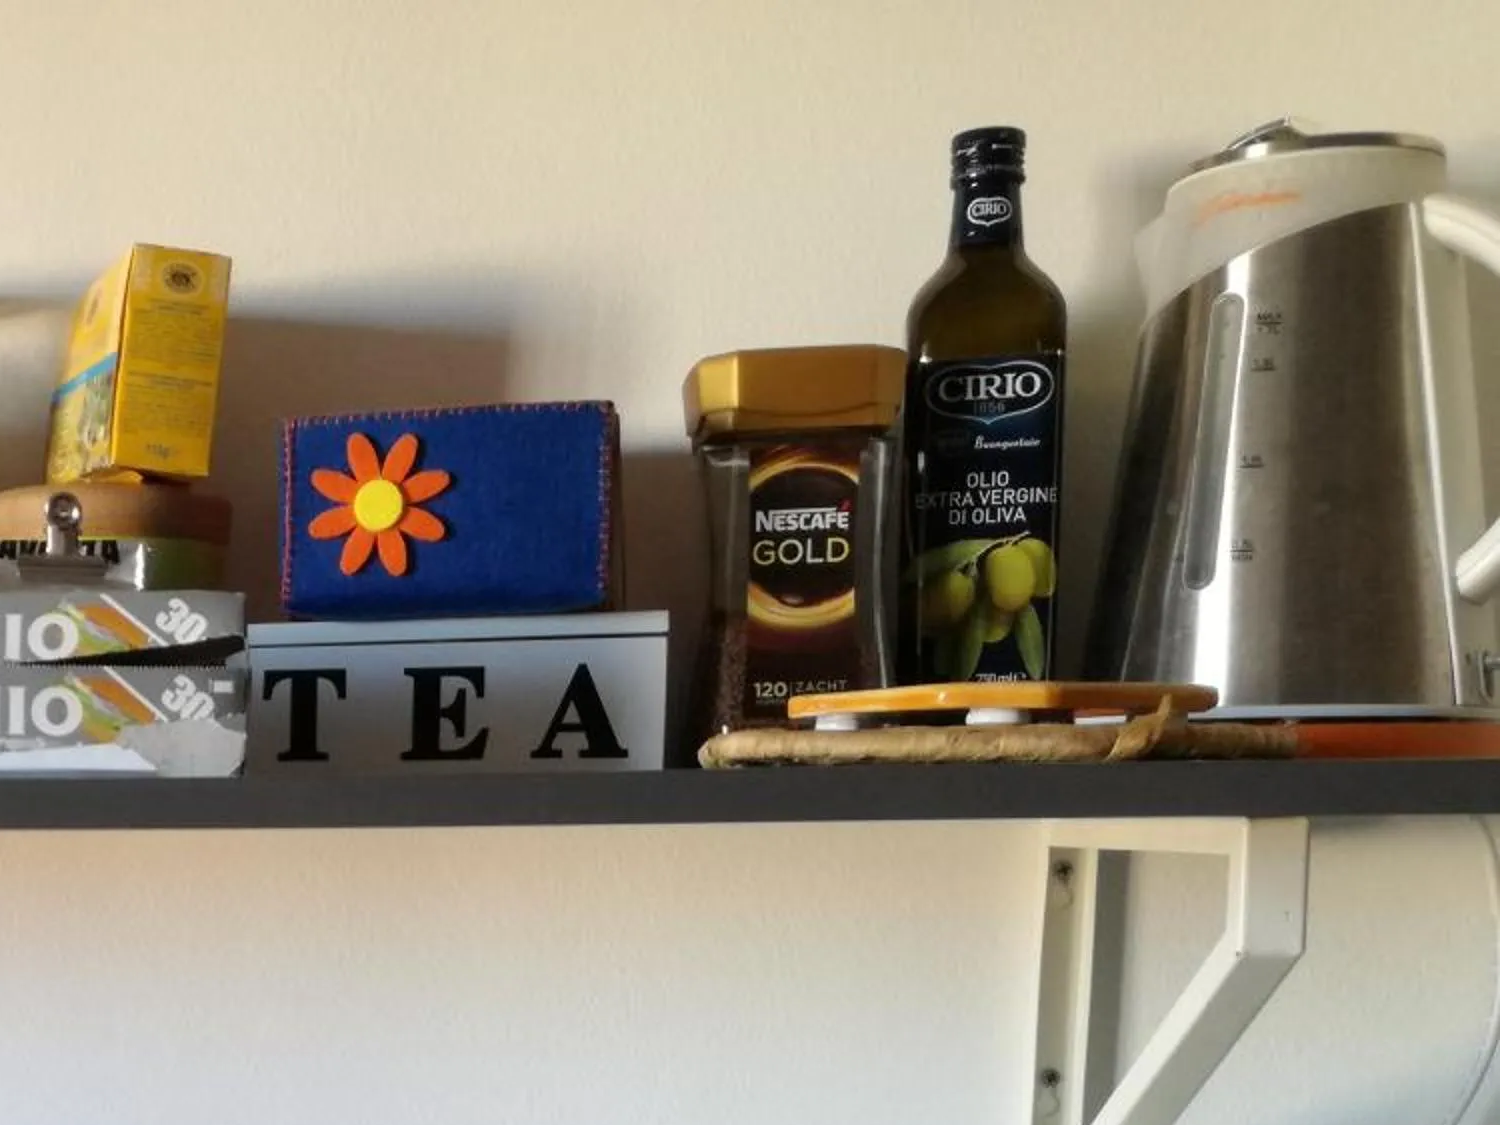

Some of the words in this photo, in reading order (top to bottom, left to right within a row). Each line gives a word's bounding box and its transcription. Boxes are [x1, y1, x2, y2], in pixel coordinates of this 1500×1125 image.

[971, 203, 1007, 217] CIRIO
[939, 371, 1042, 403] CIRIO
[966, 471, 1010, 489] OLIO
[916, 490, 974, 509] EXTRA
[978, 486, 1059, 506] VERGINE
[949, 508, 967, 526] DI
[971, 505, 1027, 526] OLIVA
[752, 537, 851, 567] GOLD
[155, 597, 209, 645] 30
[753, 681, 788, 698] 120
[795, 679, 848, 694] ZACHT
[261, 662, 630, 763] TEA
